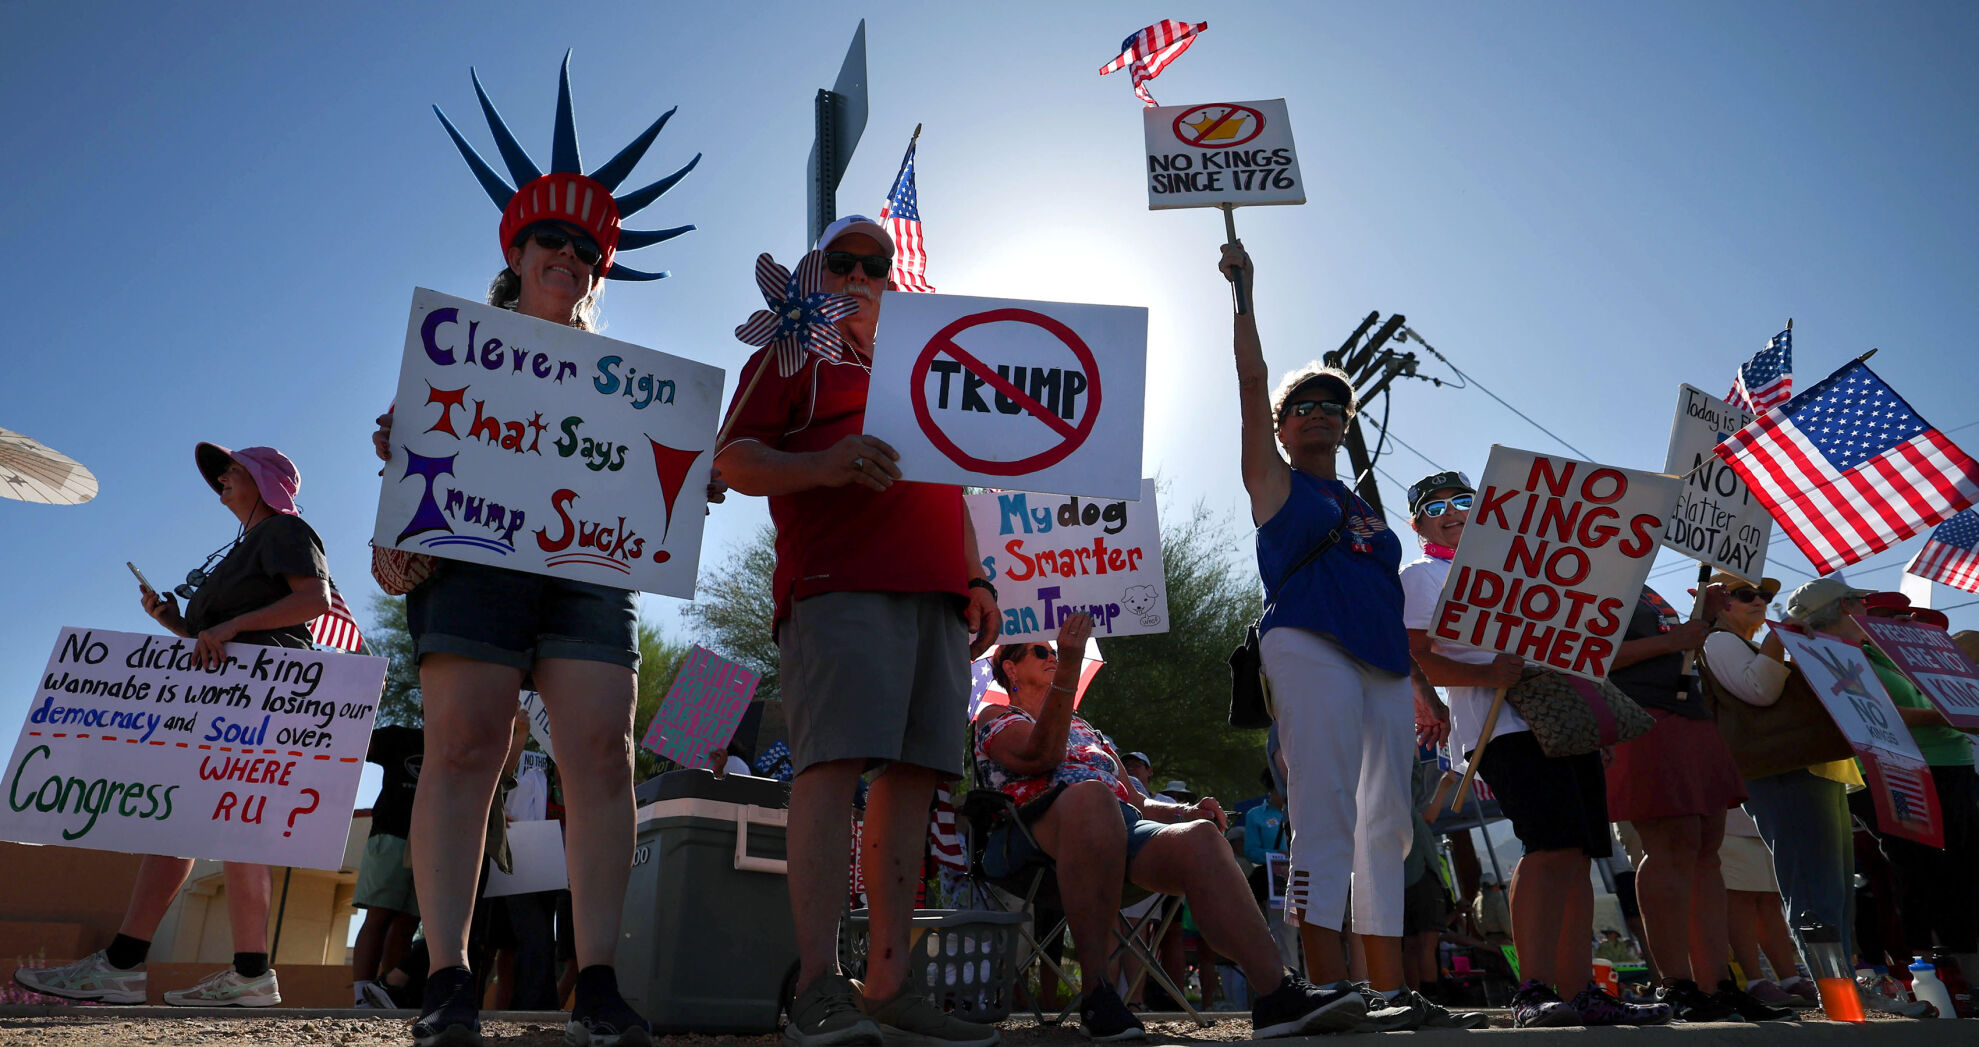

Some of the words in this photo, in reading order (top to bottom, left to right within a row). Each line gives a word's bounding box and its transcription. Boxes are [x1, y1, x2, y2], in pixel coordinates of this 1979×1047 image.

[1149, 153, 1193, 172] NO
[1202, 148, 1292, 170] KINGS
[1152, 171, 1224, 194] SINCE
[1233, 168, 1295, 191] 1776
[421, 307, 577, 384] Clever
[592, 355, 676, 410] Sign
[931, 360, 1087, 420] TRUMP
[1686, 387, 1719, 432] Today
[1724, 411, 1735, 432] is
[423, 378, 549, 456] That
[553, 416, 630, 472] Says
[395, 443, 525, 547] Trump
[1525, 457, 1628, 504] NO
[998, 493, 1053, 535] My
[1057, 496, 1127, 535] dog
[1476, 485, 1662, 559] KINGS
[1739, 524, 1761, 547] an
[982, 556, 996, 581] s
[1004, 537, 1143, 582] Smarter
[1503, 535, 1592, 587] NO
[1717, 535, 1758, 574] DAY
[1000, 606, 1040, 636] an
[1453, 566, 1624, 637] IDIOTS
[59, 631, 108, 665] No
[1435, 600, 1614, 678] EITHER
[1868, 622, 1955, 649] PRESIDENTS
[1898, 645, 1942, 669] ARE
[1929, 649, 1974, 674] NOT
[31, 697, 160, 742] democracy
[164, 712, 197, 733] and
[156, 677, 179, 703] is
[185, 683, 251, 709] worth
[262, 687, 335, 728] losing
[339, 703, 372, 720] our
[1847, 695, 1888, 729] NO
[643, 720, 715, 768] EMPATH
[693, 710, 735, 749] YOUR
[1865, 724, 1899, 746] KINGS
[200, 755, 296, 785] WHERE
[524, 754, 534, 766] NO
[9, 745, 180, 840] Congress
